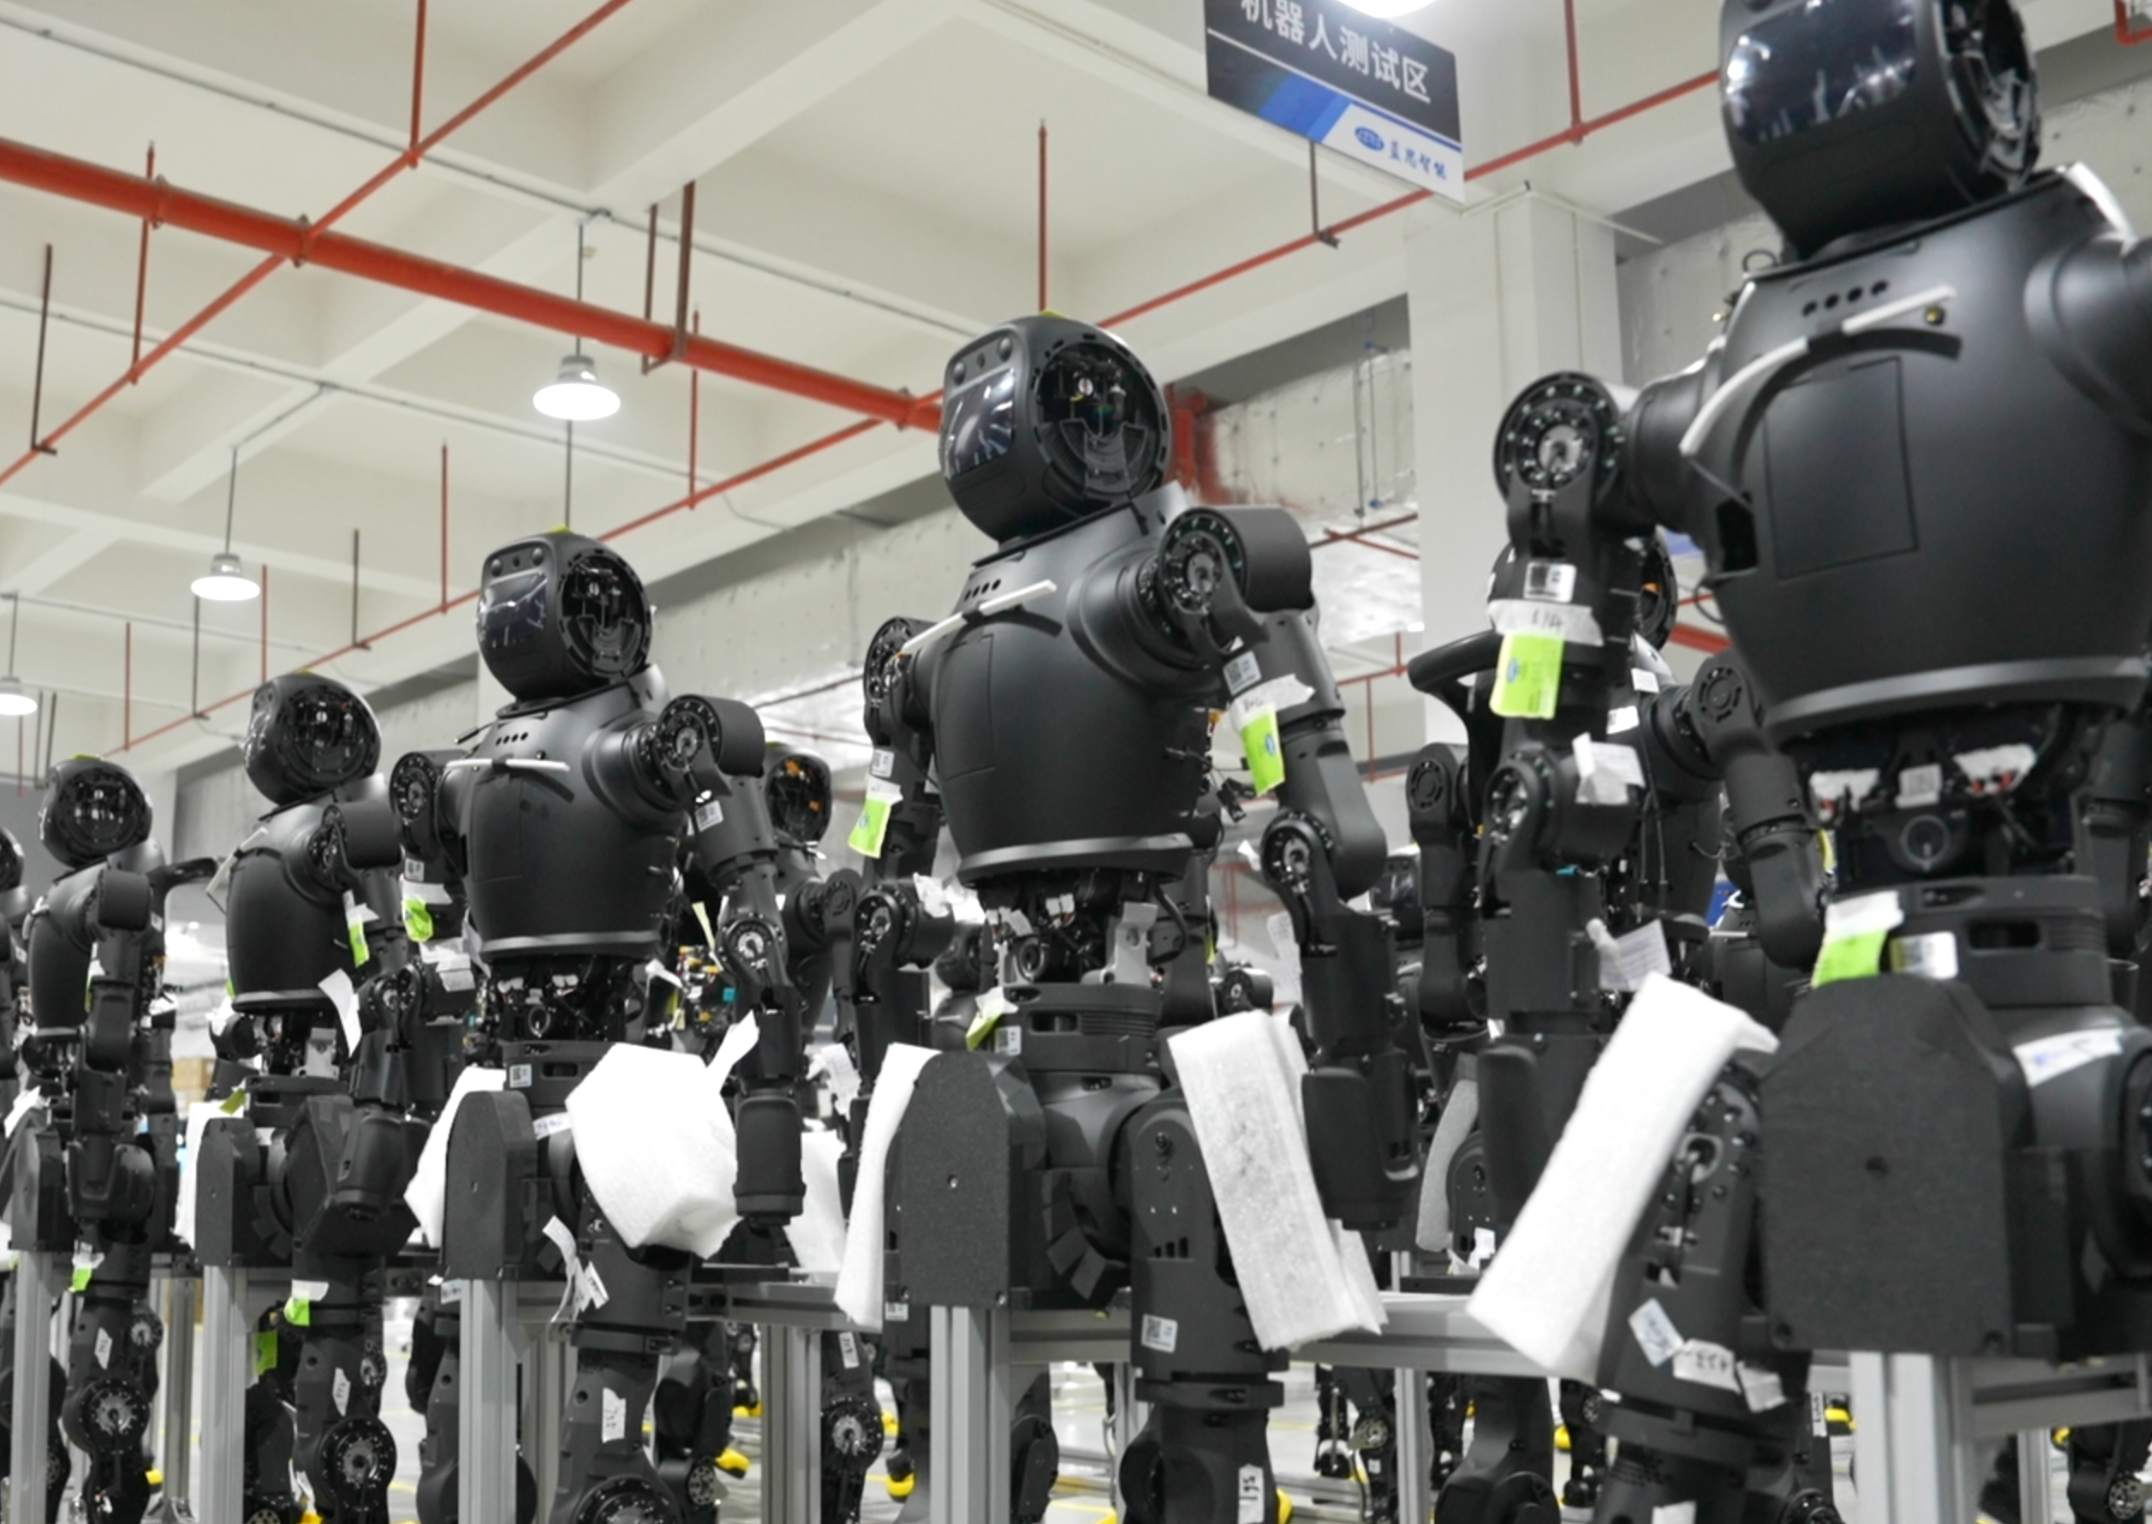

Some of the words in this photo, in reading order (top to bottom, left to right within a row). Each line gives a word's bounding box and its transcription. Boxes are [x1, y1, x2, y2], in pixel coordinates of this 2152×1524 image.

[1241, 0, 1431, 104] 机器人测试区
